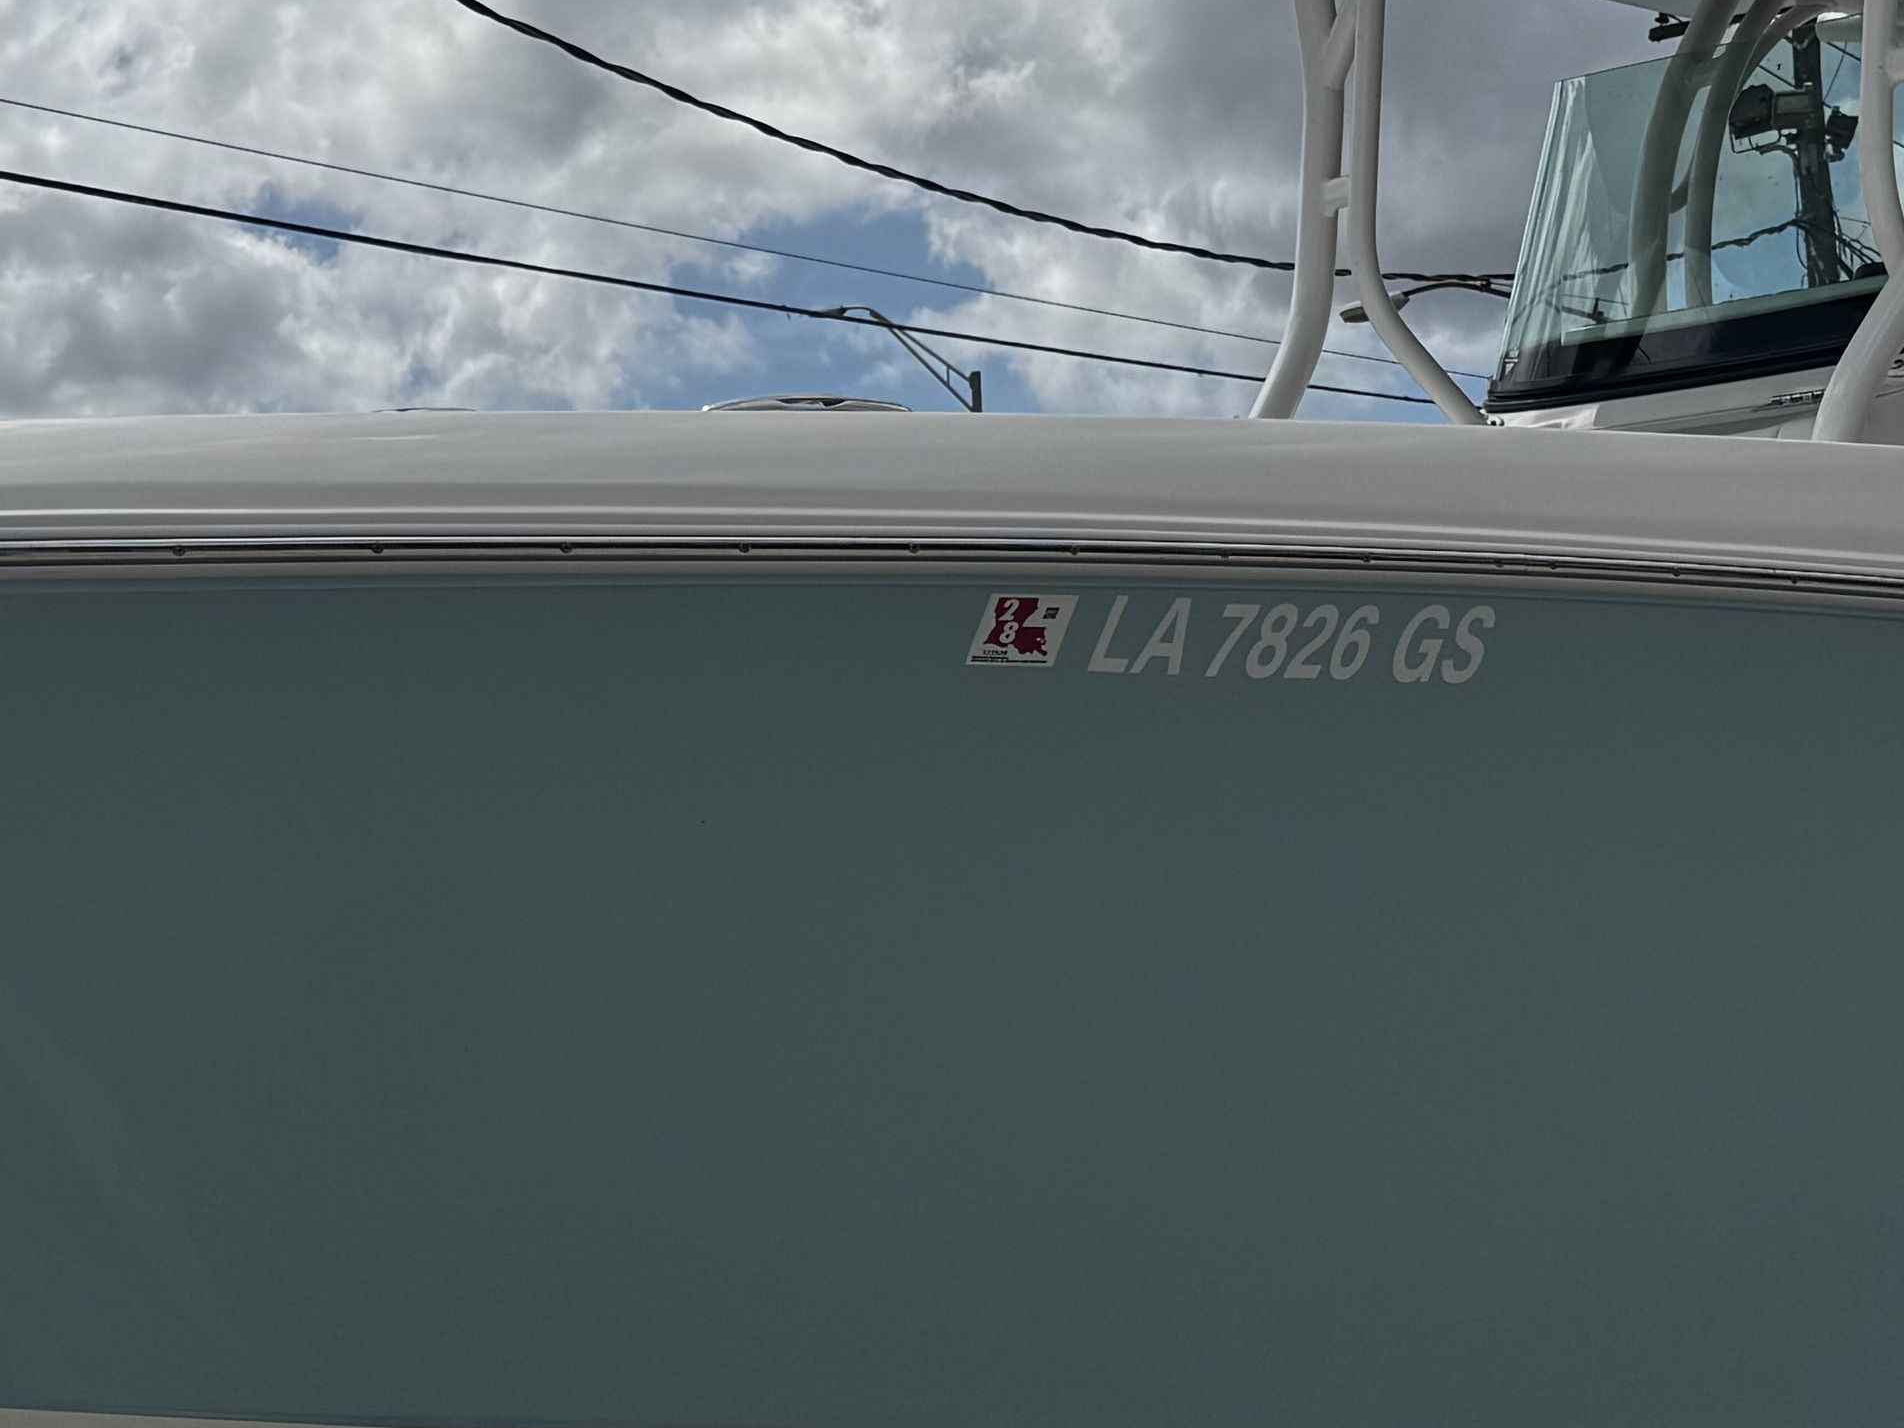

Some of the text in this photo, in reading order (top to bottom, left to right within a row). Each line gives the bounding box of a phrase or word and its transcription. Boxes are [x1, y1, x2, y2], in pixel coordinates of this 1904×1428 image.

[1087, 595, 1495, 684] LA 7826 GS
